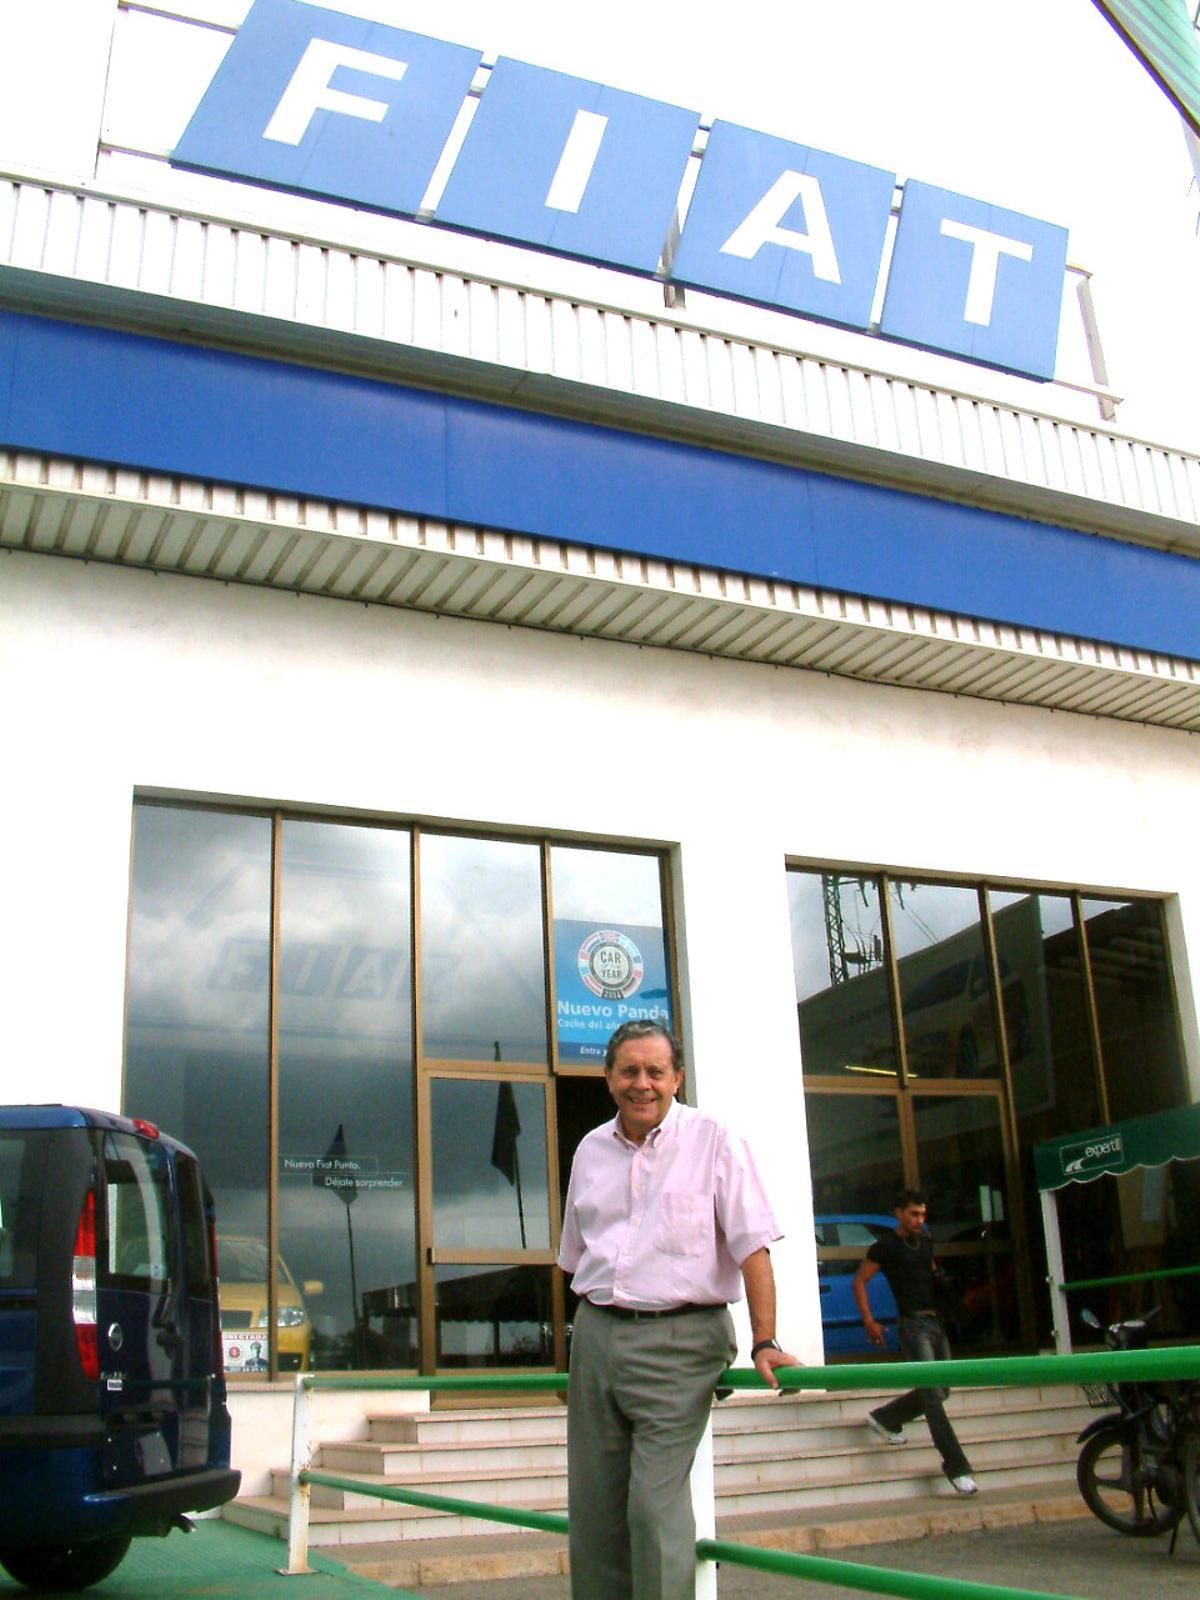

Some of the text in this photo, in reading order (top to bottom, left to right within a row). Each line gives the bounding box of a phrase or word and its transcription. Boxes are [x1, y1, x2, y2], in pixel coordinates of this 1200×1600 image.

[262, 38, 1033, 327] FIAT
[600, 951, 621, 964] CAR
[602, 970, 622, 978] YEAR
[557, 1000, 669, 1020] Nuevo Panda
[558, 1018, 585, 1028] Coche
[588, 1020, 604, 1029] del
[580, 1046, 608, 1057] Entra y
[284, 1159, 315, 1169] Nuevo
[316, 1159, 332, 1169] Fiat
